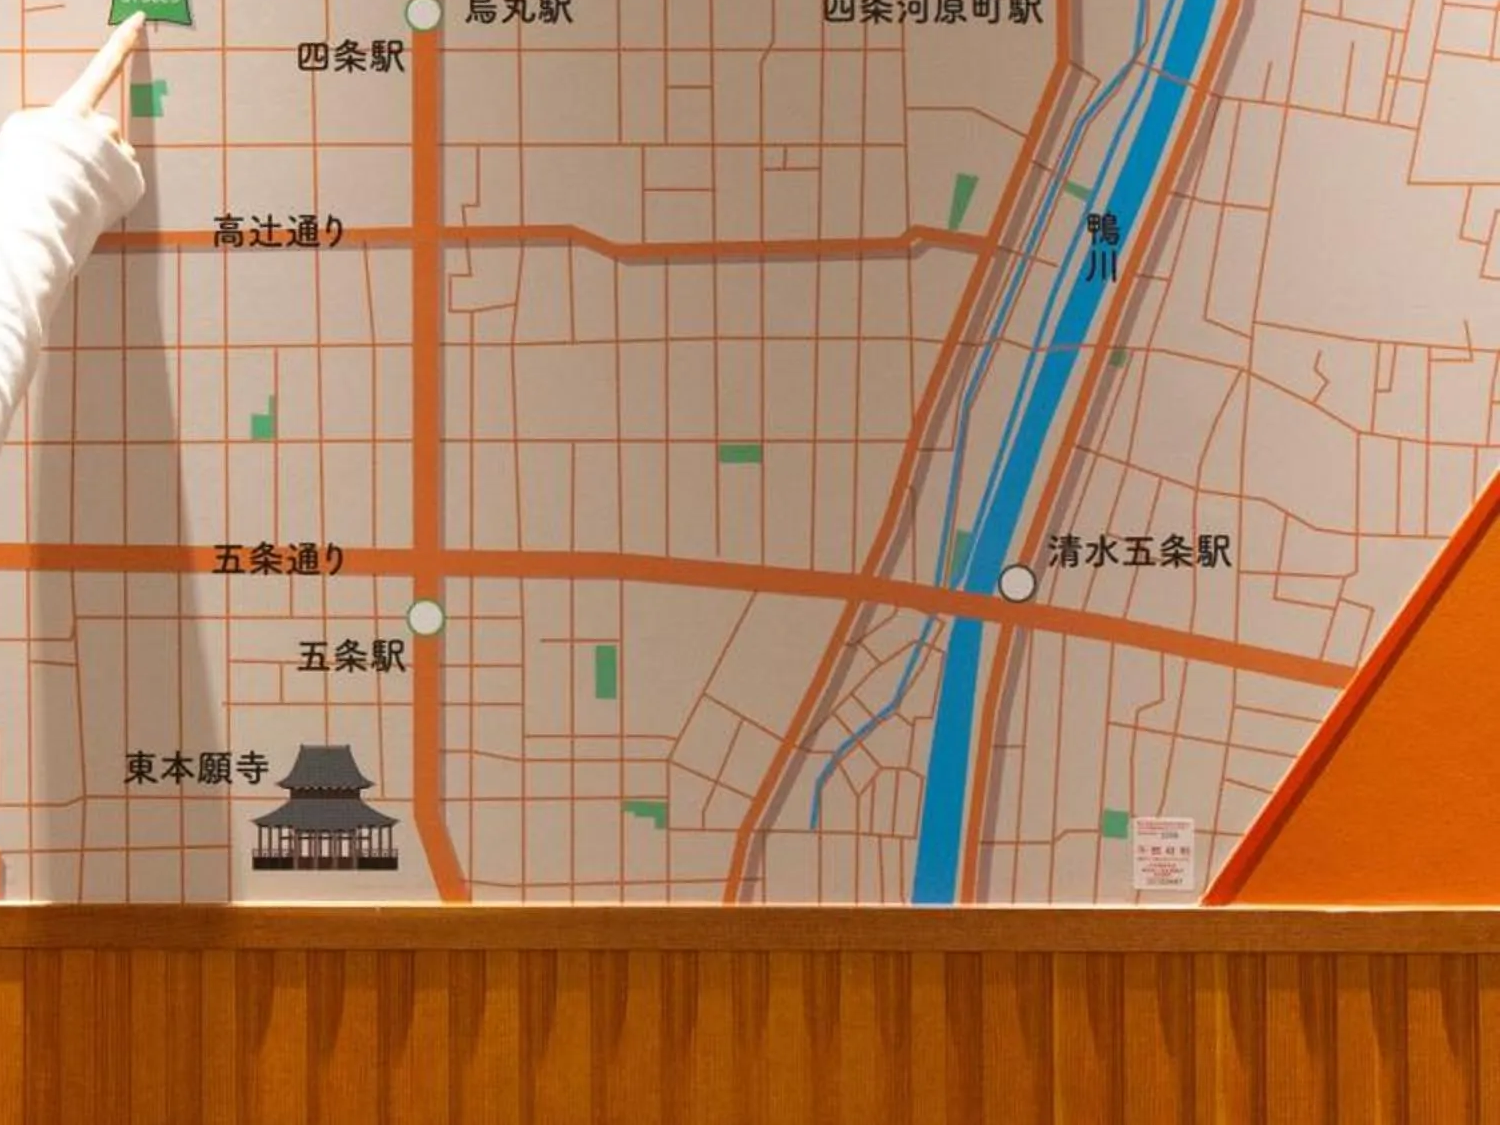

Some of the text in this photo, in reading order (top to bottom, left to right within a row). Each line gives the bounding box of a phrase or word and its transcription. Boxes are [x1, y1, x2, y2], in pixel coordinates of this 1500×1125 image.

[297, 39, 405, 73] 四条駅
[213, 214, 345, 249] 高辻通り
[1085, 213, 1120, 283] 鴨川
[212, 542, 345, 576] 五条通り
[1048, 533, 1232, 568] 清水五条駅
[297, 639, 406, 673] 五条駅
[123, 750, 270, 785] 東本願寺
